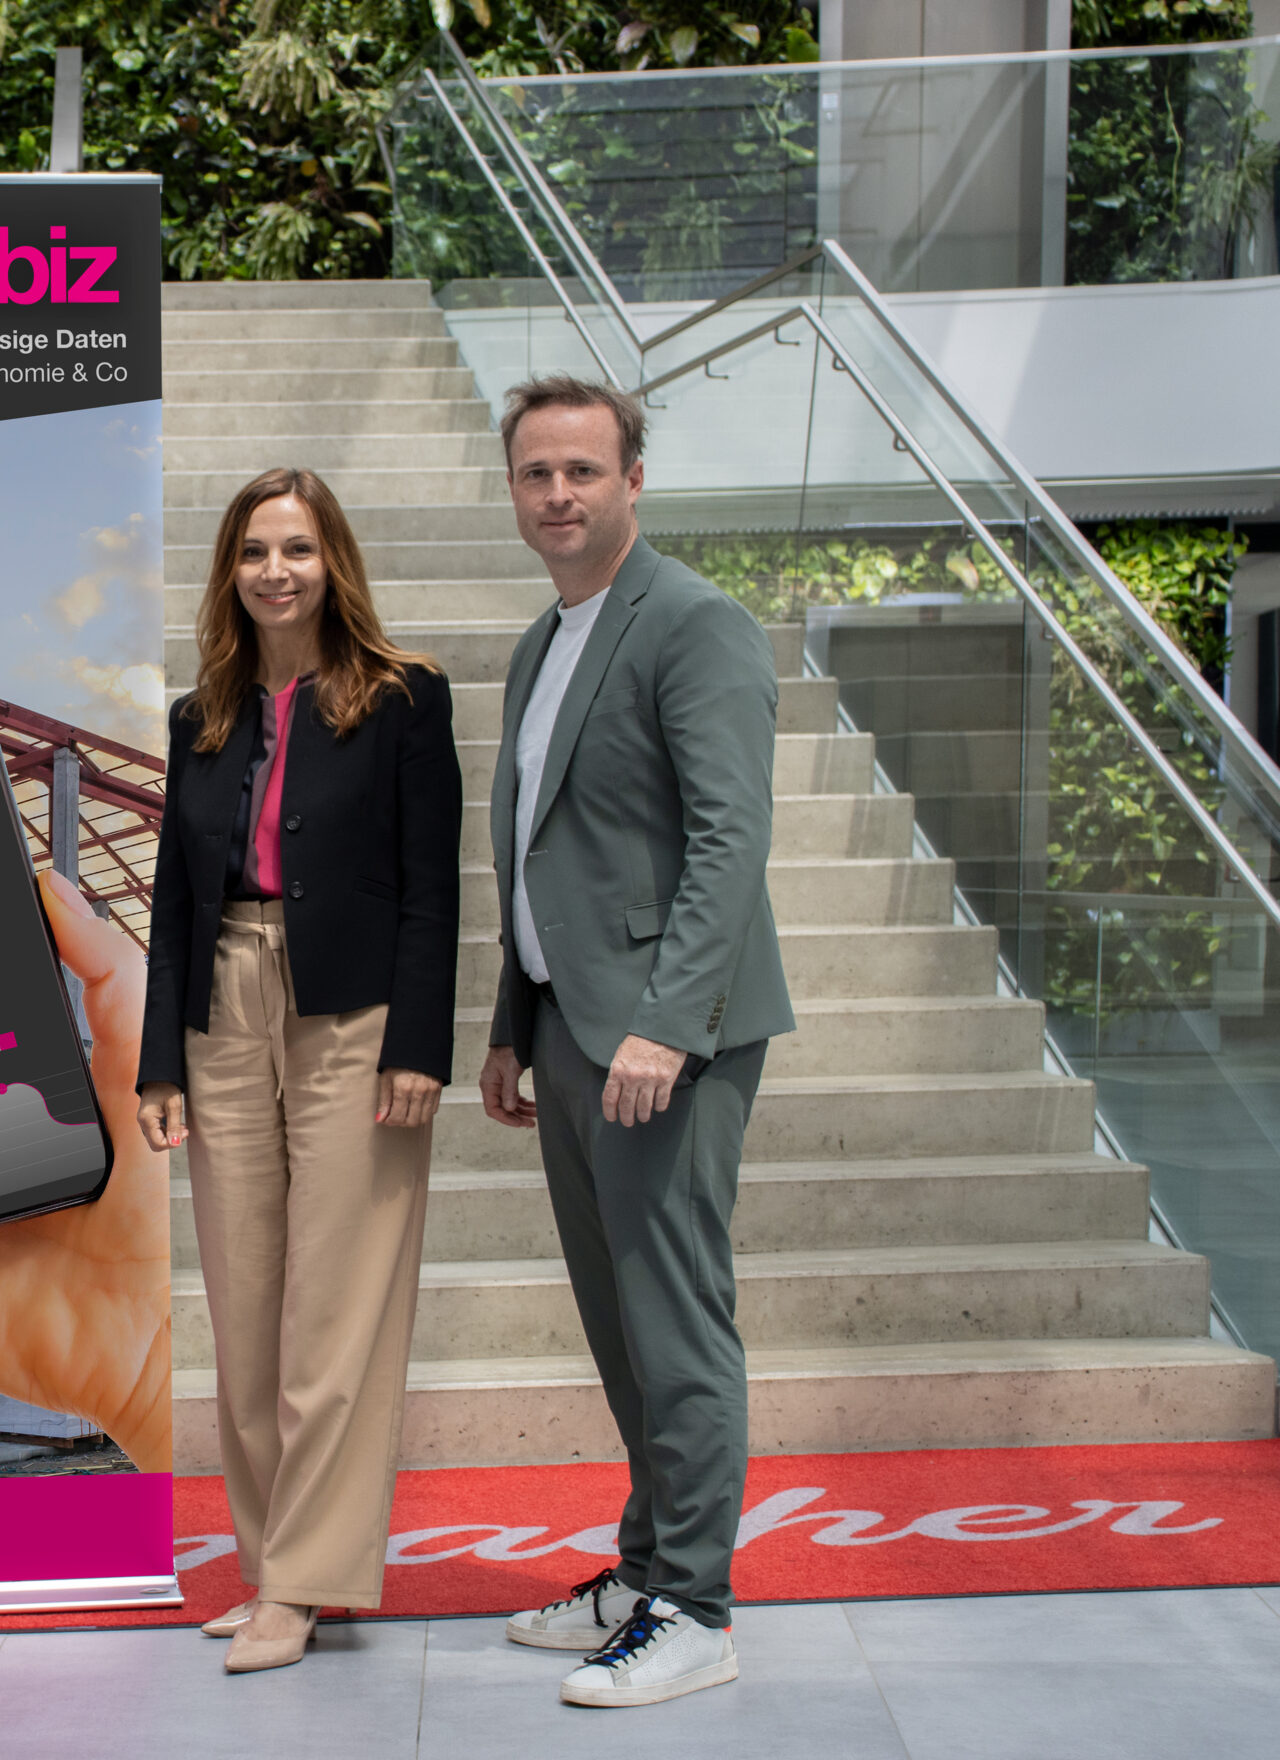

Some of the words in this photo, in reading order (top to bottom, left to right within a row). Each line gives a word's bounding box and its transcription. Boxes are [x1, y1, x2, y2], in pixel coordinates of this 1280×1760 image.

[56, 329, 127, 349] Daten
[72, 362, 89, 383] &
[95, 361, 128, 382] Co
